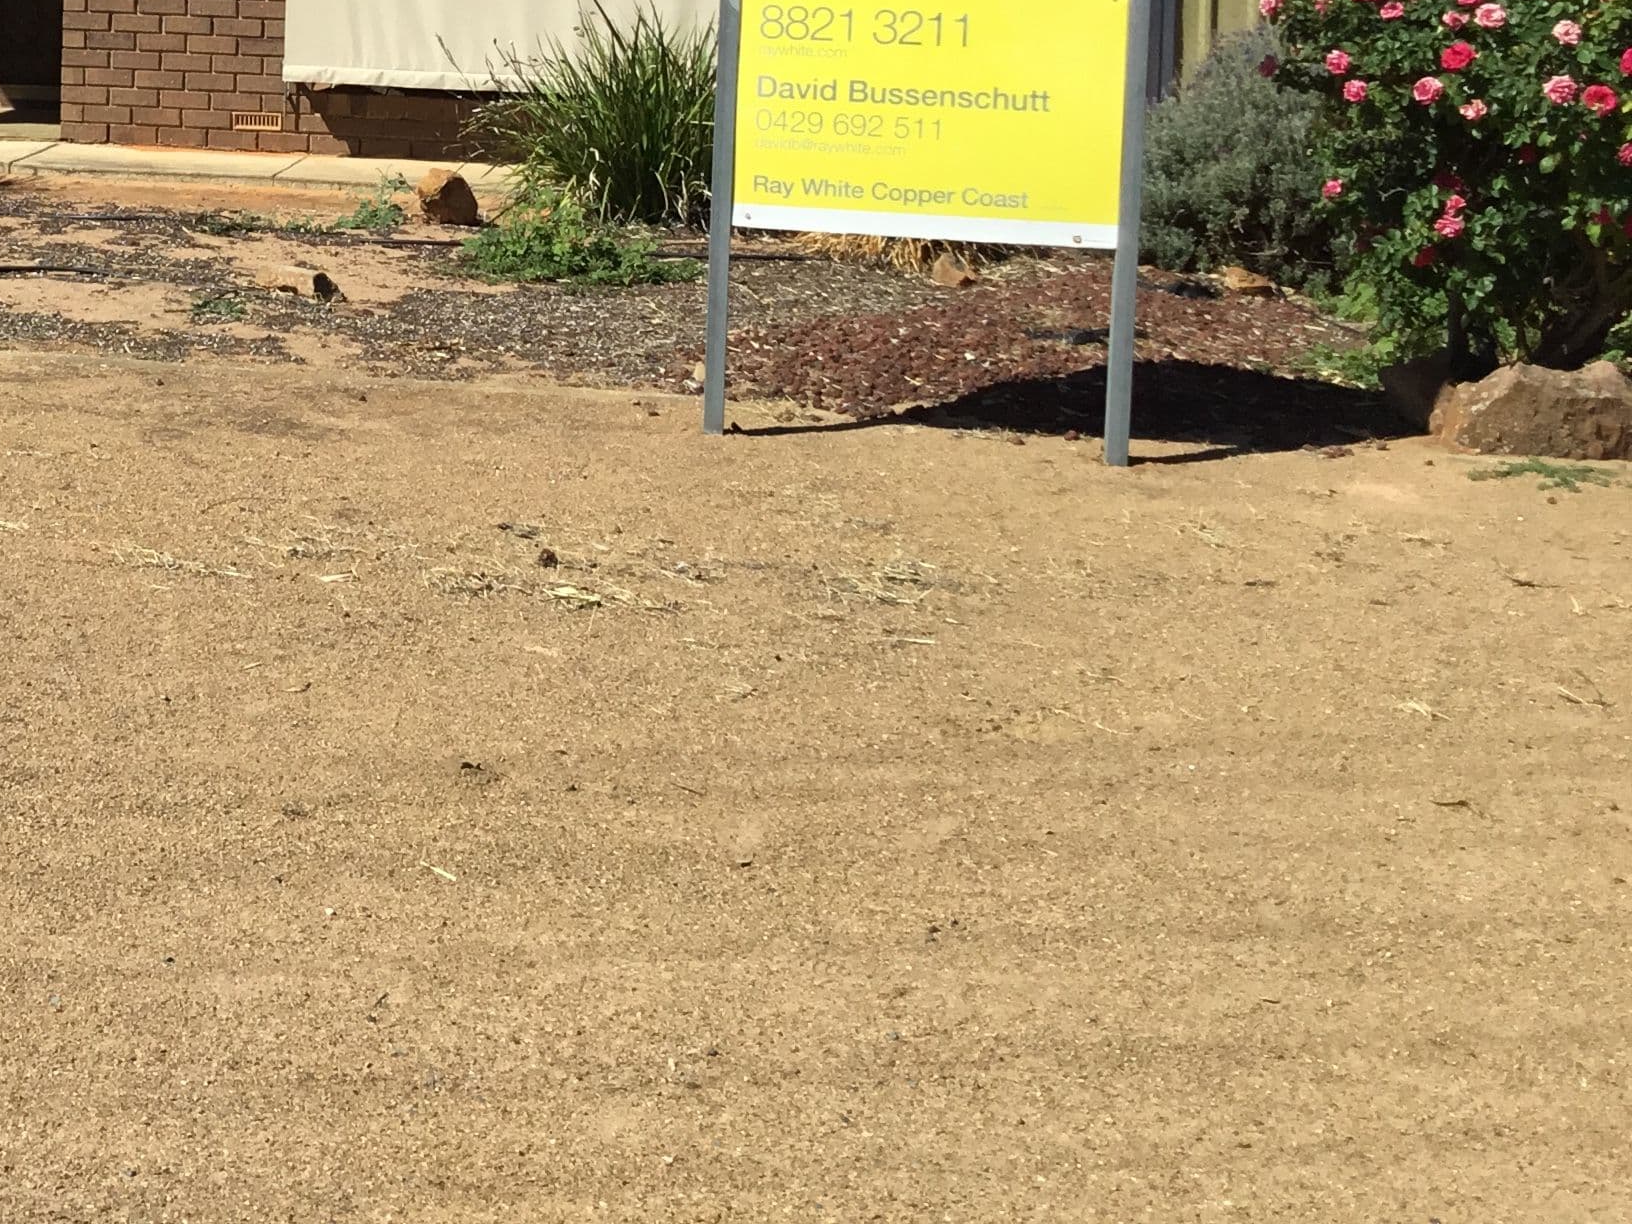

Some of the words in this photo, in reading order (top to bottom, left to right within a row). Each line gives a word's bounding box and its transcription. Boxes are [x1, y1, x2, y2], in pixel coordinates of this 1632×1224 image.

[760, 5, 854, 42] 8821
[873, 9, 969, 47] 3211
[757, 75, 838, 102] David
[849, 79, 1051, 113] Bussenschutt
[755, 109, 824, 134] 0429
[833, 113, 884, 137] 692
[894, 116, 943, 141] 511
[753, 175, 794, 199] Ray
[802, 178, 865, 199] White
[871, 182, 955, 208] Copper
[961, 187, 1029, 209] Coast
